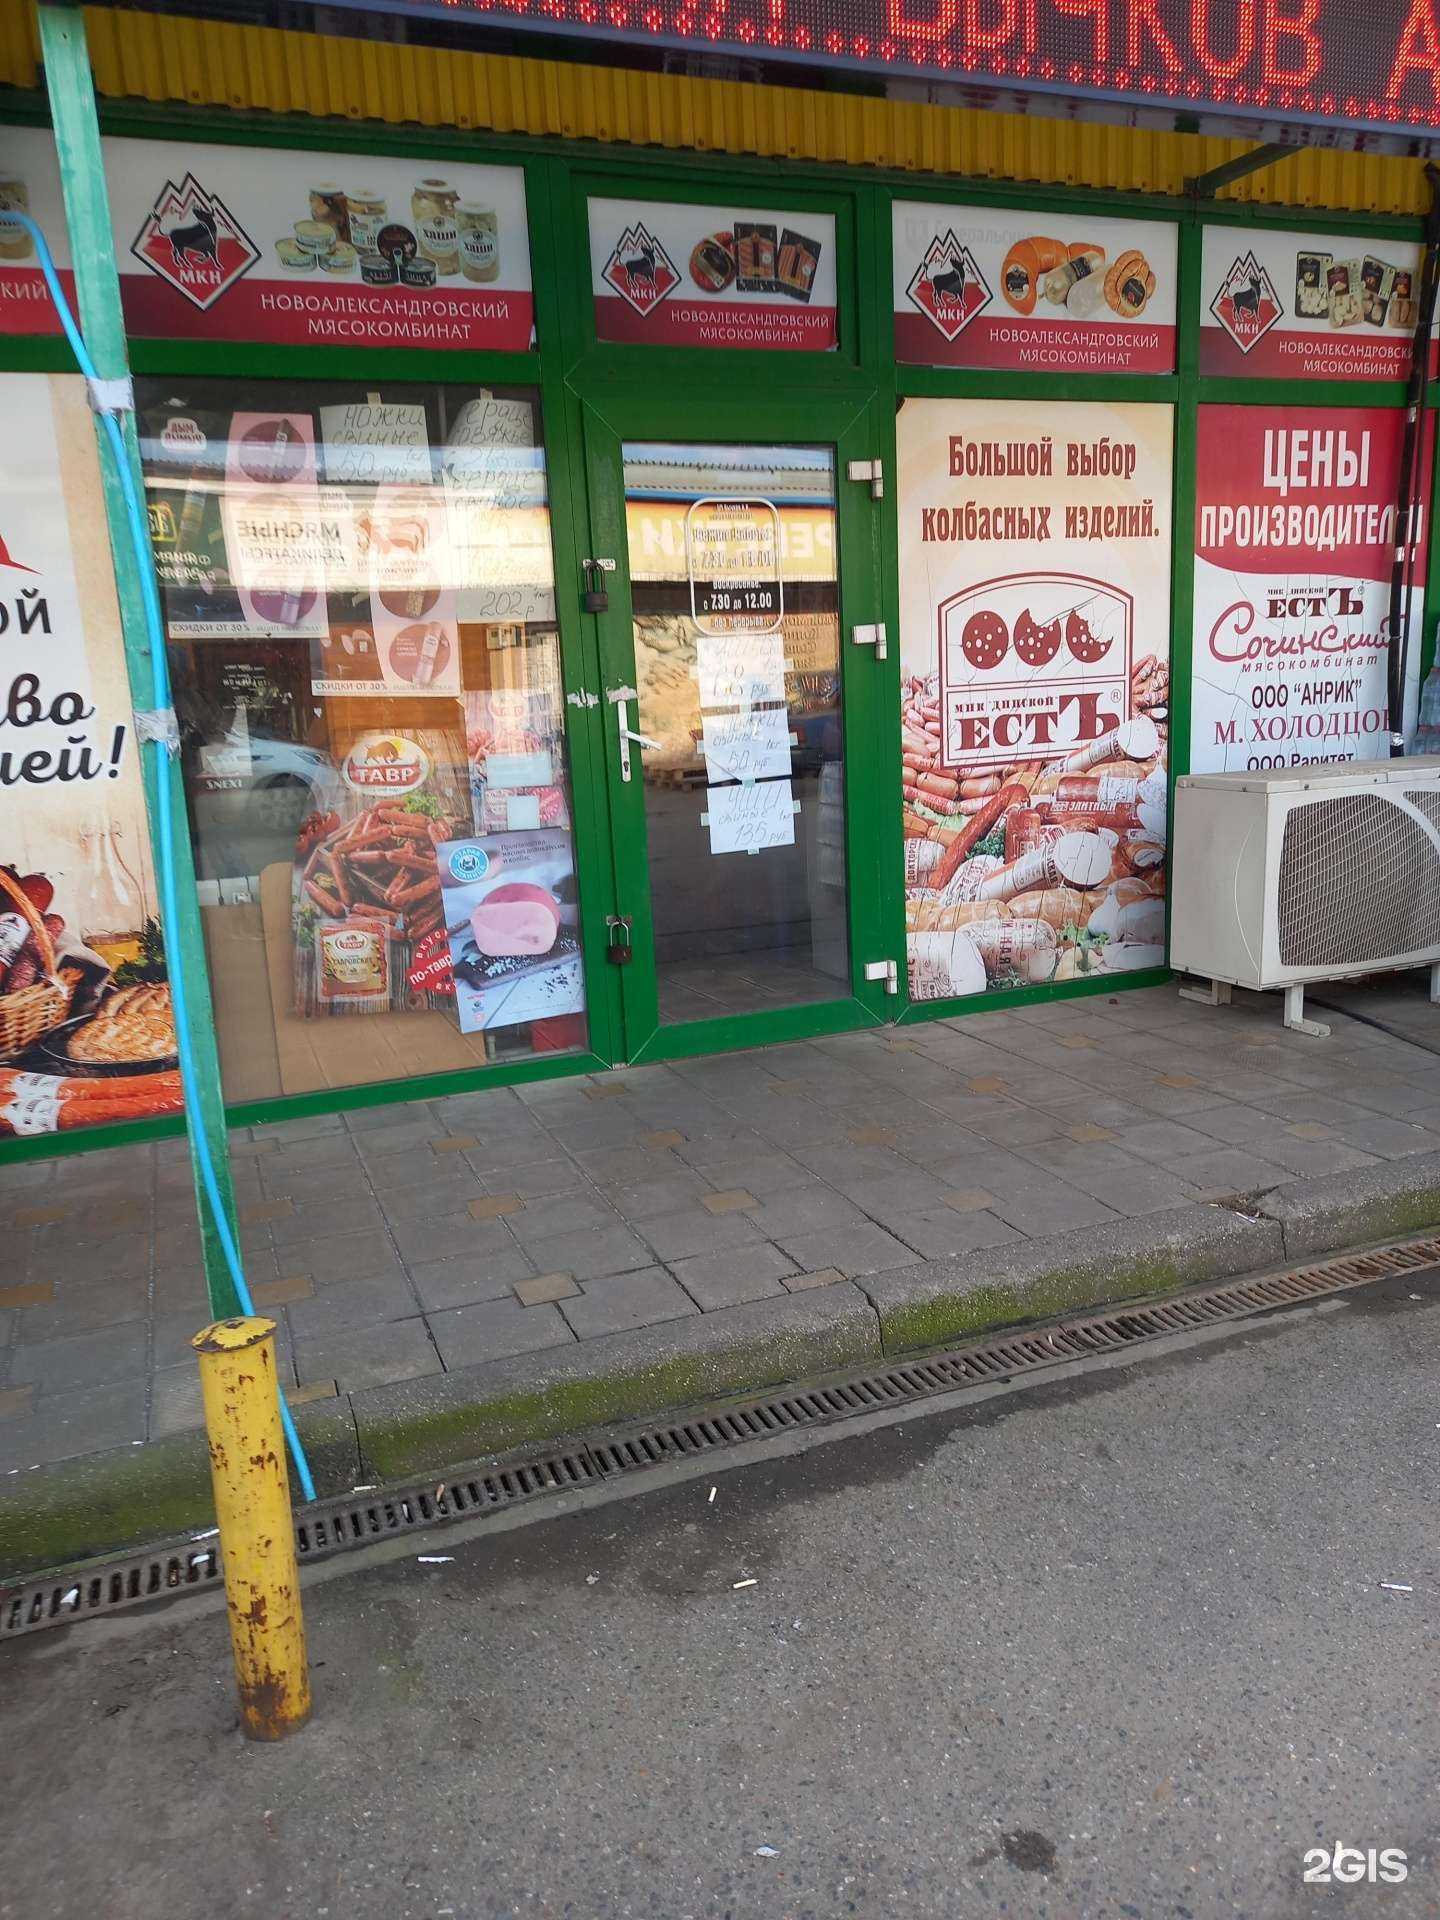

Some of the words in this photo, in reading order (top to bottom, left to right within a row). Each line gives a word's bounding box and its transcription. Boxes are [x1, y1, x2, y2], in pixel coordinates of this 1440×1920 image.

[180, 269, 222, 286] МКН
[630, 288, 657, 300] МКН
[261, 294, 509, 319] НОВОАЛЕКСАНДРОВСКИЙ
[936, 308, 965, 321] МКН
[671, 309, 829, 328] НОВОАЛЕКСАНДРОВСКИЙ
[308, 318, 471, 339] МЯСОКОМБИНАТ
[700, 327, 804, 342] МЯСОКОМБИНАТ
[1234, 322, 1259, 335] МКН
[990, 328, 1159, 349] НОВОАЛЕКСАНДРОВСКИЙ
[1019, 349, 1131, 366] МЯСОКОМБИНАТ
[1279, 341, 1413, 360] НОВОАЛЕКСАНДРОВСК
[1303, 360, 1400, 377] МЯСОКОМБИНАТ
[949, 436, 1053, 477] Большой
[1067, 437, 1136, 480] выбор
[1263, 430, 1371, 497] ЦЕНЫ
[922, 501, 1051, 542] колбасных
[1065, 498, 1160, 542] изделий.
[1201, 498, 1423, 552] ПРОИЗВОДИТЕЛ
[480, 590, 522, 617] 202
[710, 593, 730, 610] 7.30
[744, 592, 772, 609] 12.00
[1242, 655, 1378, 673] мясокомбинат
[1252, 684, 1289, 709] ООО
[1213, 720, 1243, 745] М.
[1247, 754, 1285, 771] ООО
[356, 768, 415, 783] ТАВР
